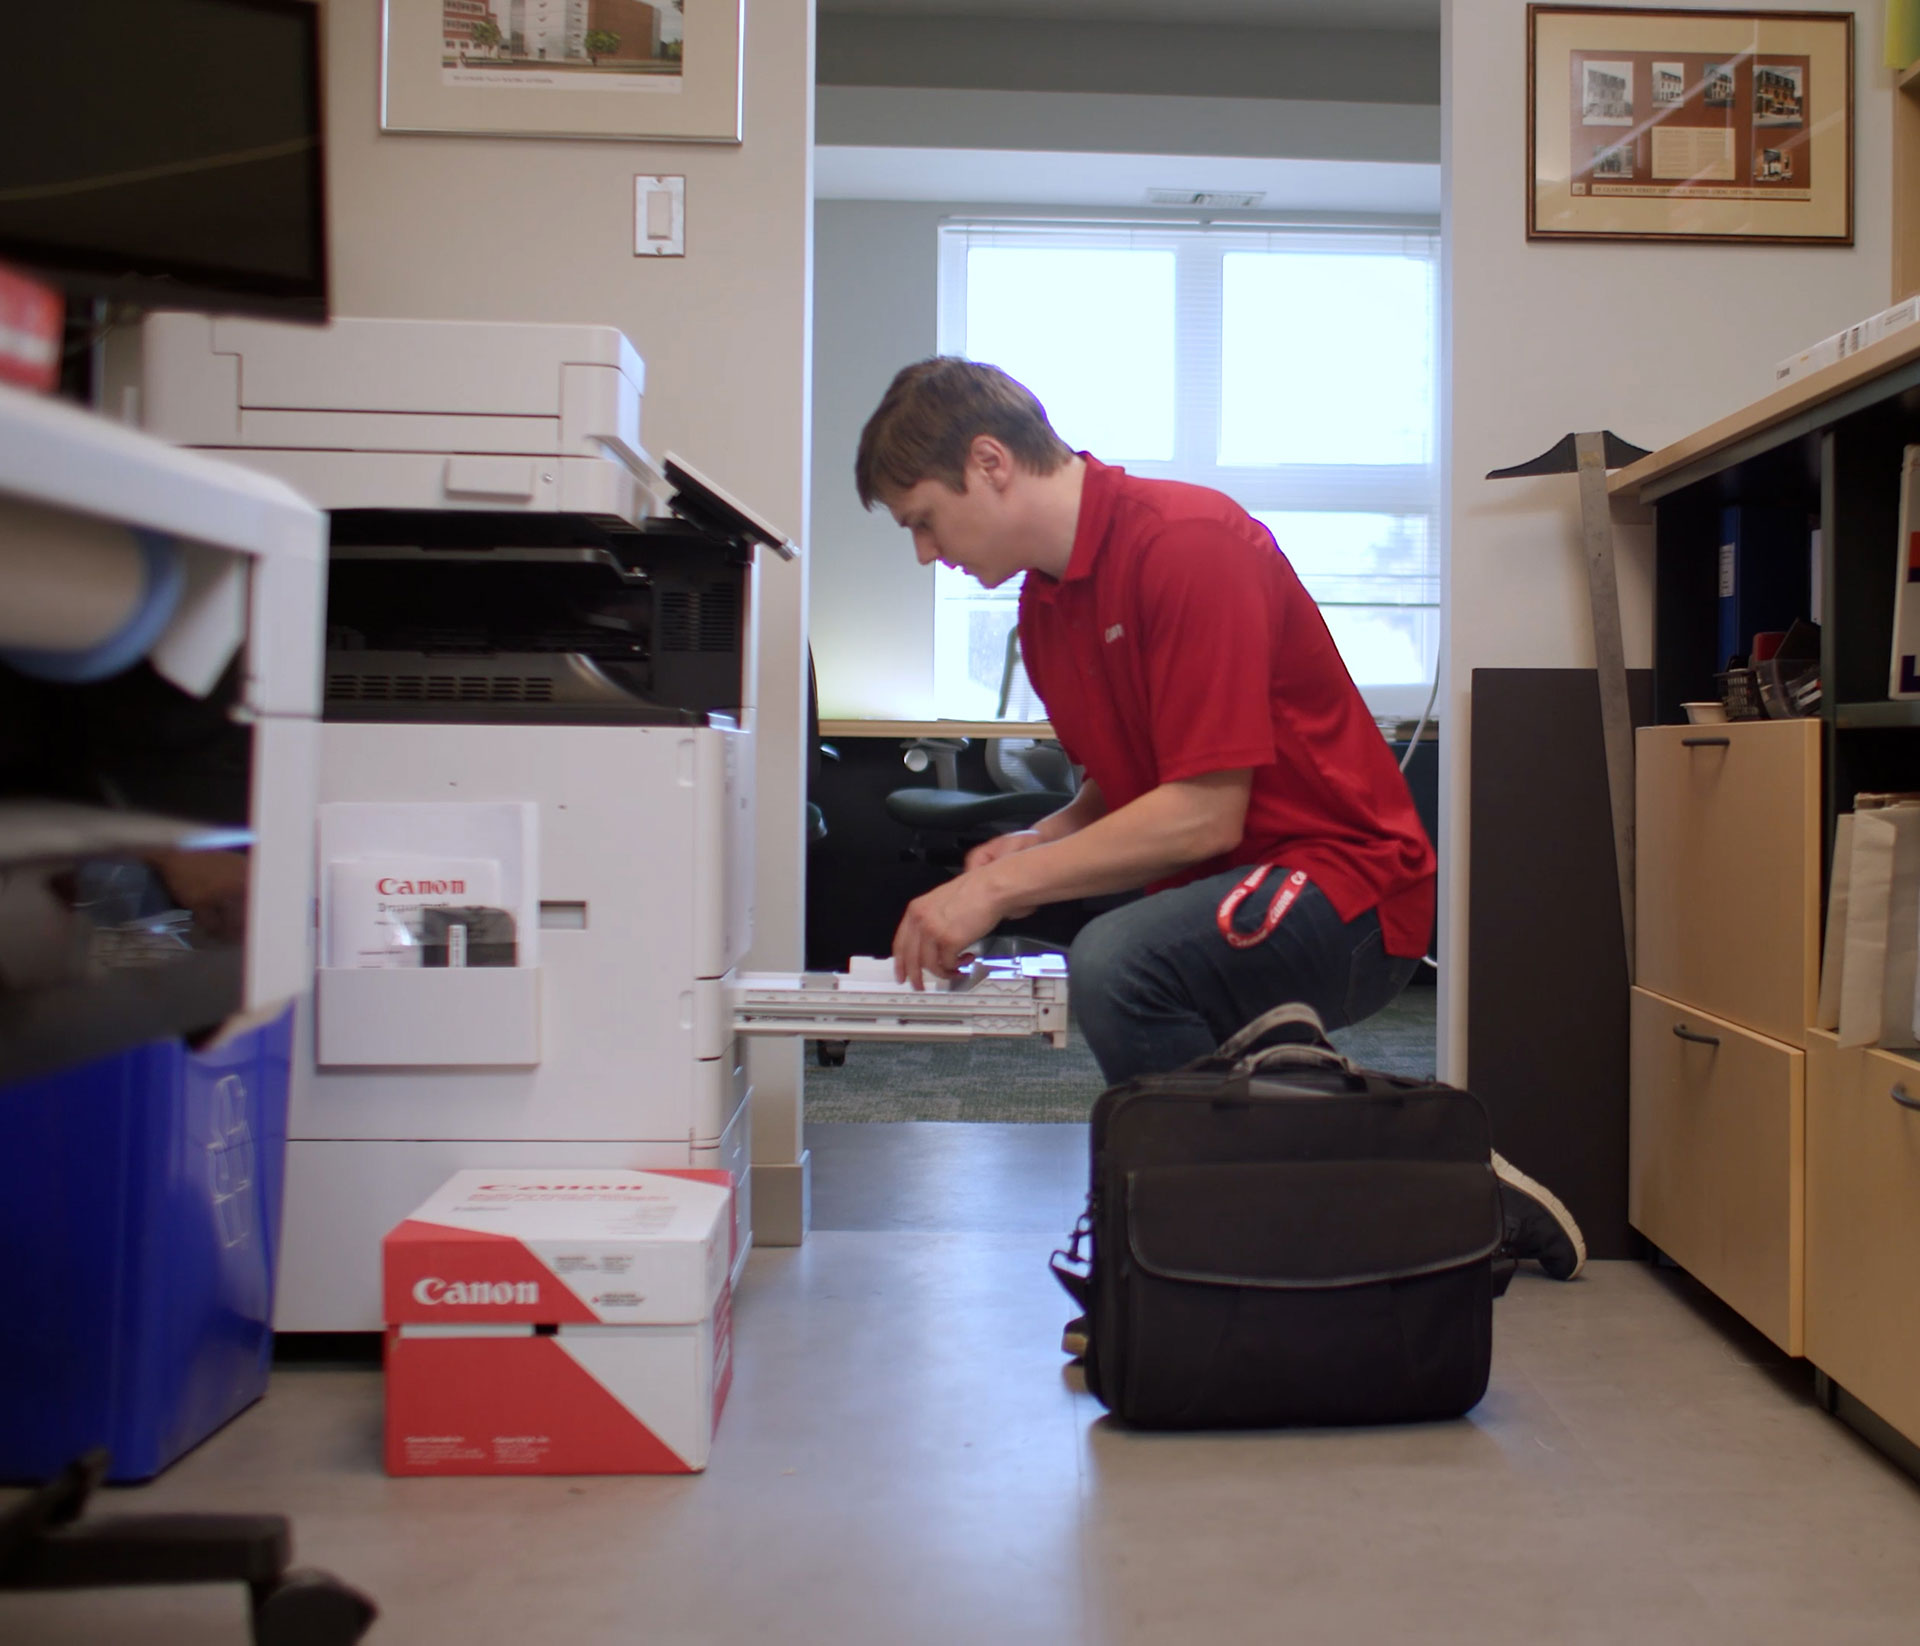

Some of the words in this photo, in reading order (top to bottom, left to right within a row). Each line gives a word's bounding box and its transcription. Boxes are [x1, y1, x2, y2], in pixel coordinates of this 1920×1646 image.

[377, 877, 465, 896] Canon
[1270, 889, 1295, 924] Canon
[477, 1183, 643, 1192] Canon
[412, 1276, 539, 1305] Canon
